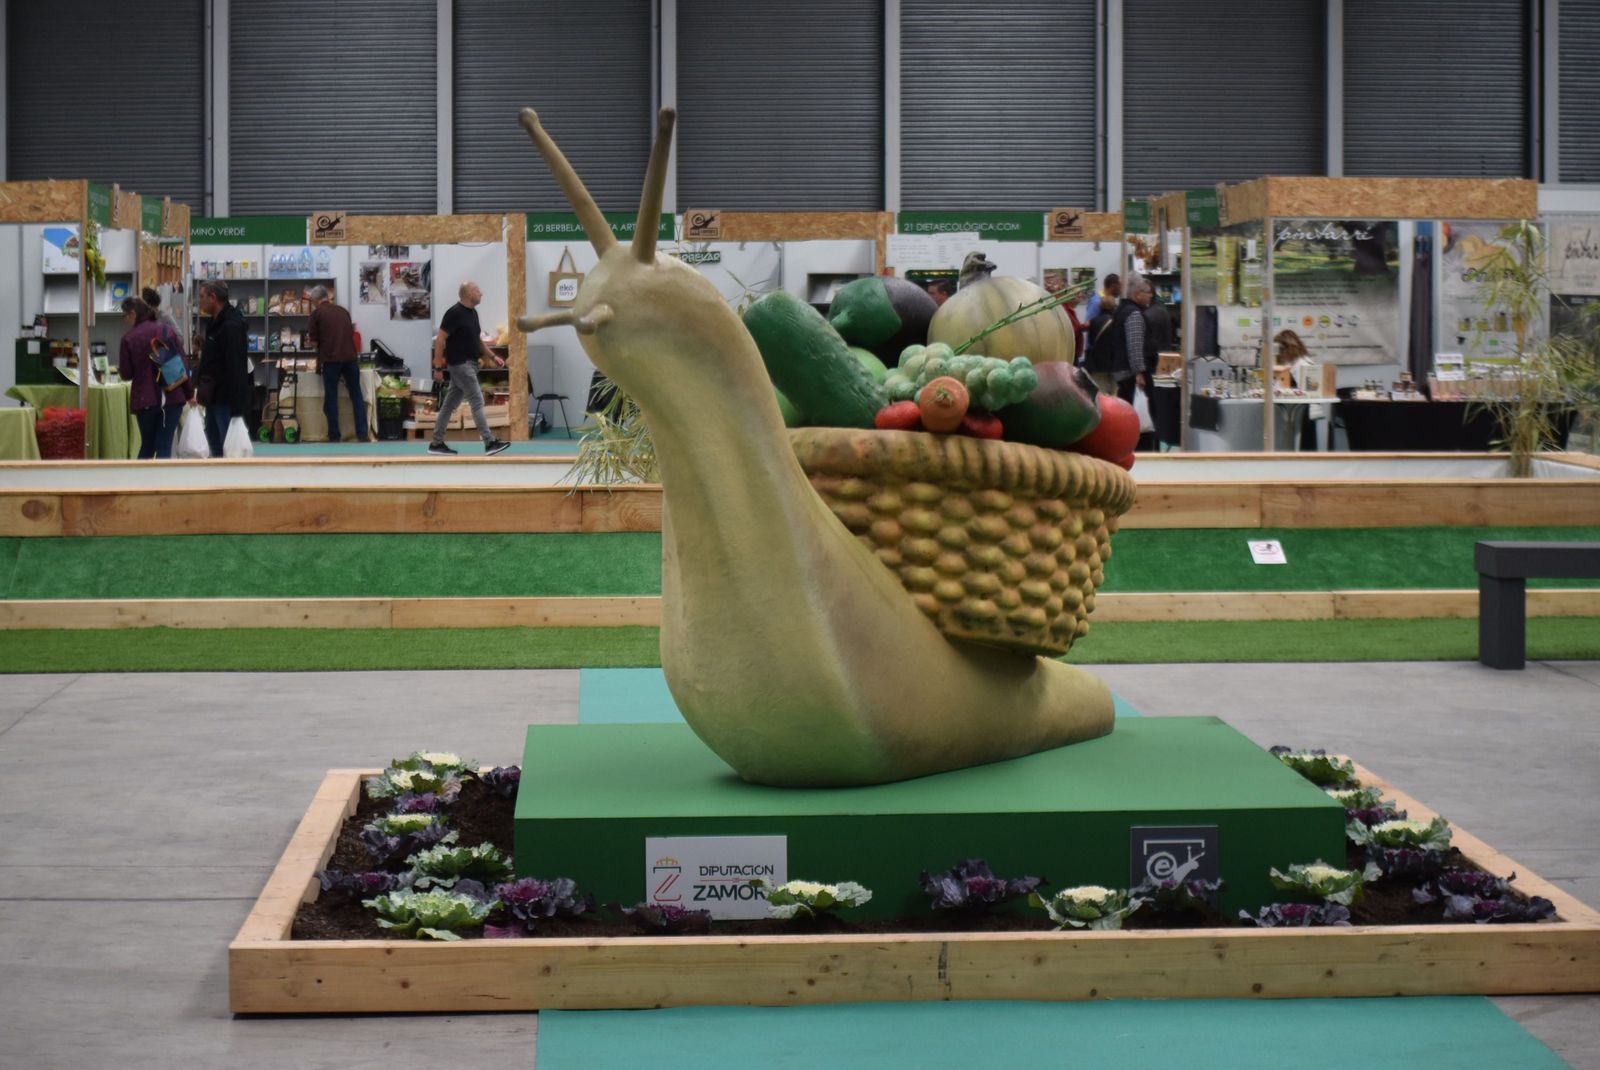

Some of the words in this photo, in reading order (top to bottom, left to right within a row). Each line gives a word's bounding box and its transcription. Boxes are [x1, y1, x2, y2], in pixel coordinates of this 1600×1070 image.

[217, 226, 246, 236] VERDE
[533, 224, 544, 233] 20
[904, 223, 914, 232] 21
[916, 221, 1020, 232] DIETAECOLÓGICA.COM
[693, 883, 767, 901] ZAMOR
